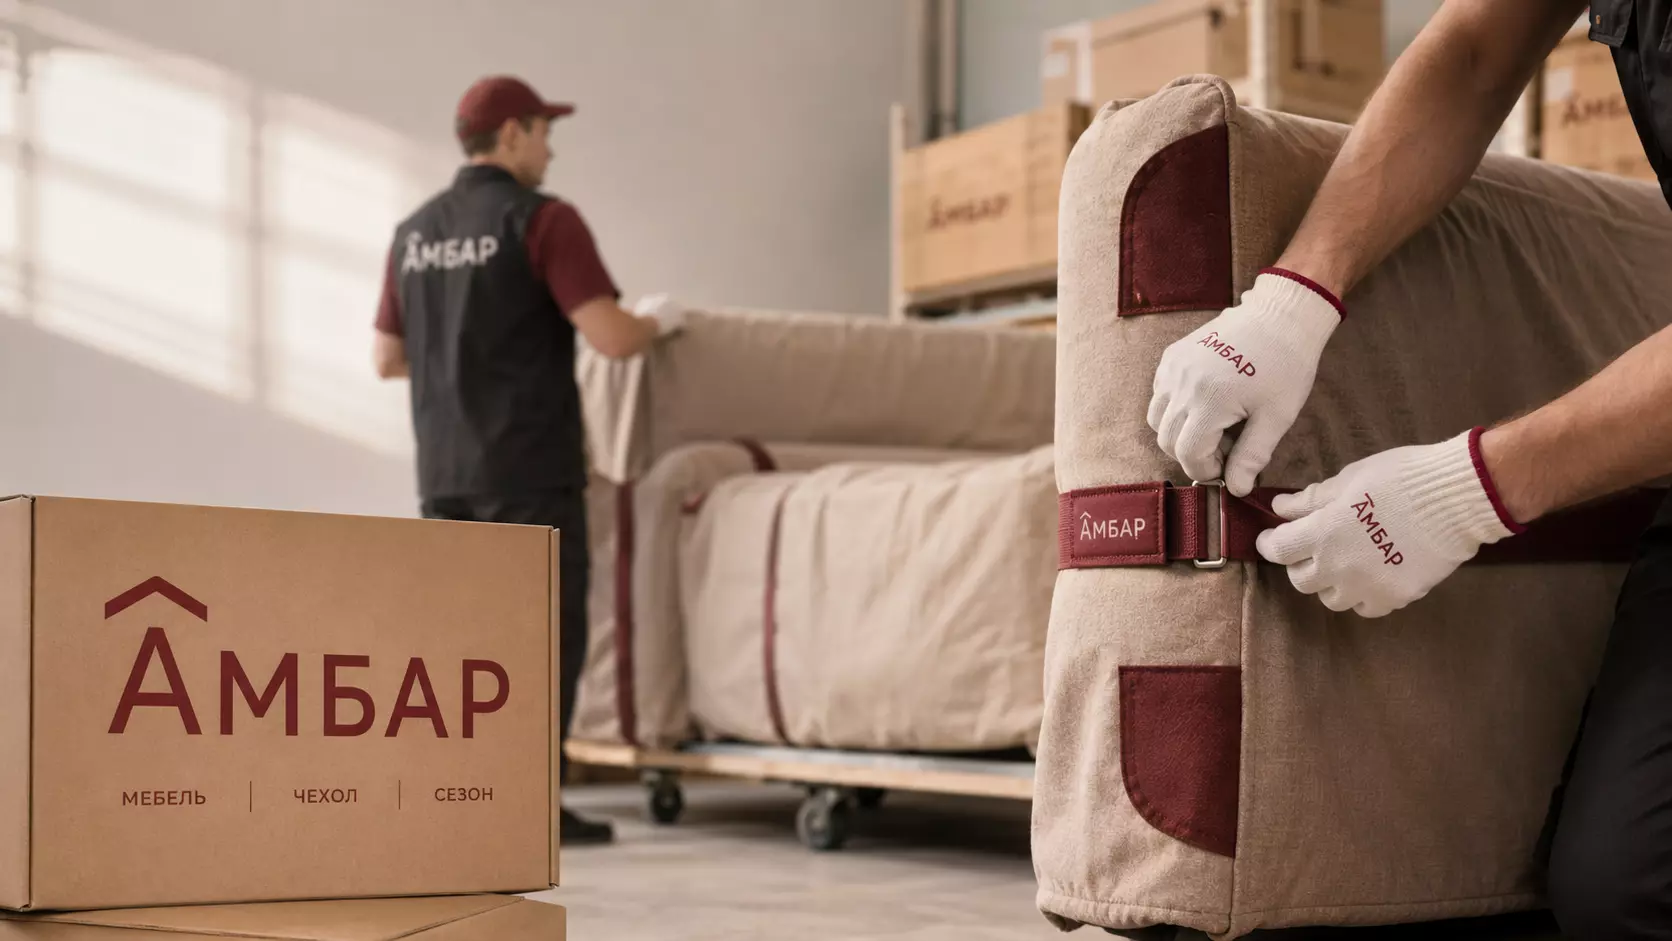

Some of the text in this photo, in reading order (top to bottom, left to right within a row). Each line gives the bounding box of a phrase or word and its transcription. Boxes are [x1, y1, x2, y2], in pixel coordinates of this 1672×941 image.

[401, 230, 498, 276] АМБАР
[1197, 331, 1256, 377] АМБАР
[1080, 511, 1146, 541] АМБАР
[1350, 492, 1404, 565] АМБАР
[104, 576, 510, 739] АМБАР
[122, 787, 494, 806] МЕБЕЛЬ ЧЕХОЛ СЕЗОН
